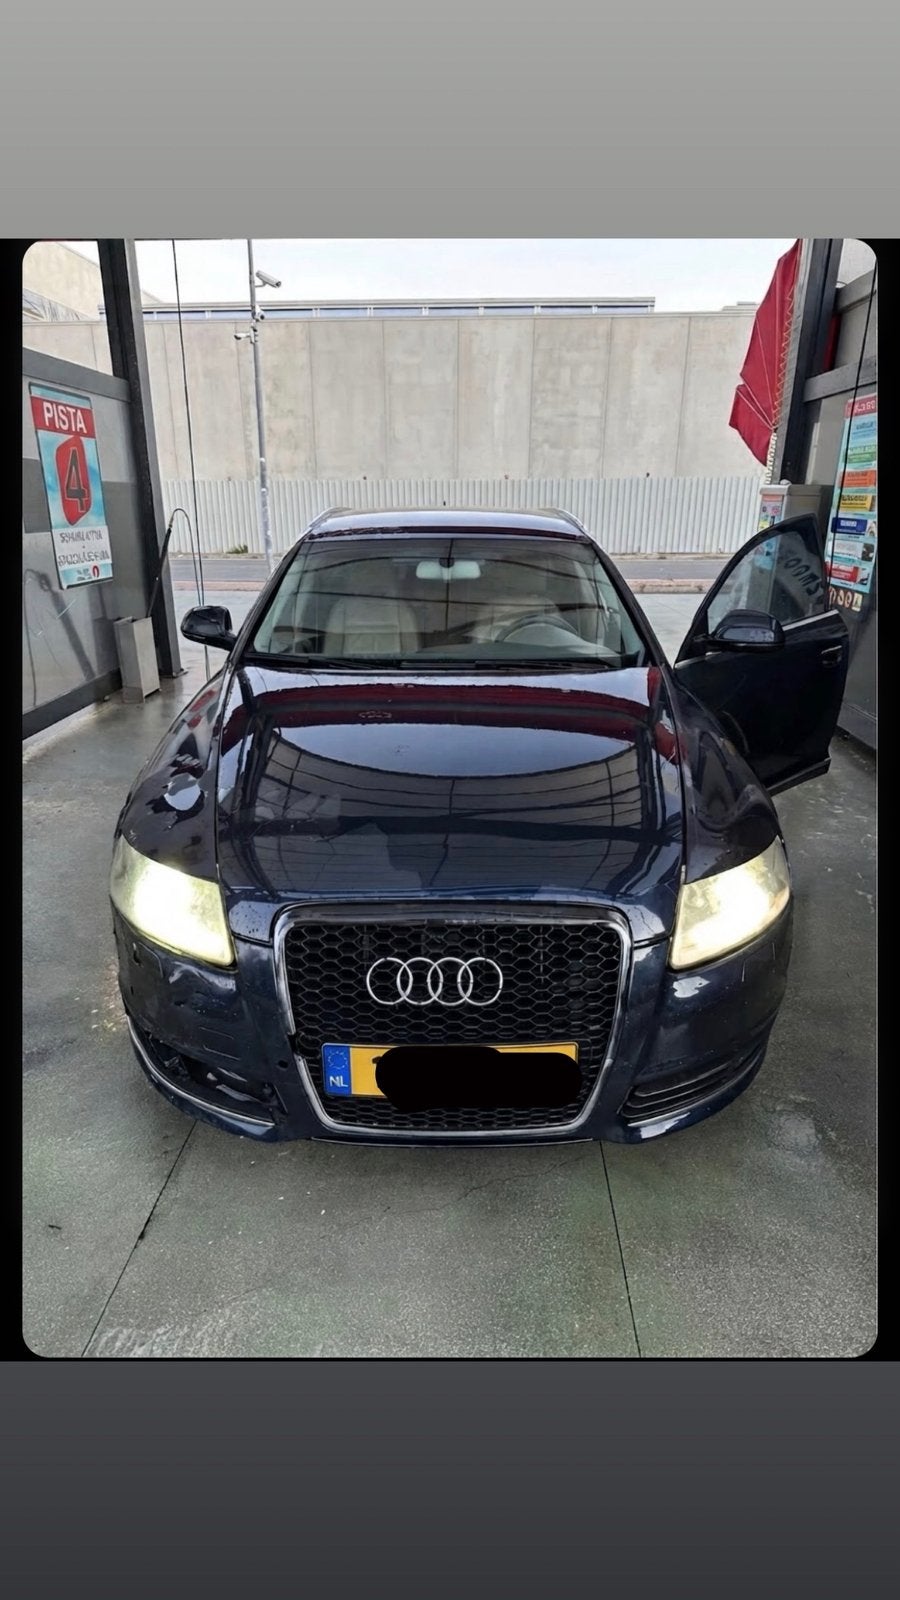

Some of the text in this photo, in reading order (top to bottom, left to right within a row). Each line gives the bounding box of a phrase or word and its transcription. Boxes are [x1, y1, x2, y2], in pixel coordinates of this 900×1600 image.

[42, 401, 87, 434] PISTA
[65, 446, 89, 512] 4
[329, 1075, 349, 1088] NL
